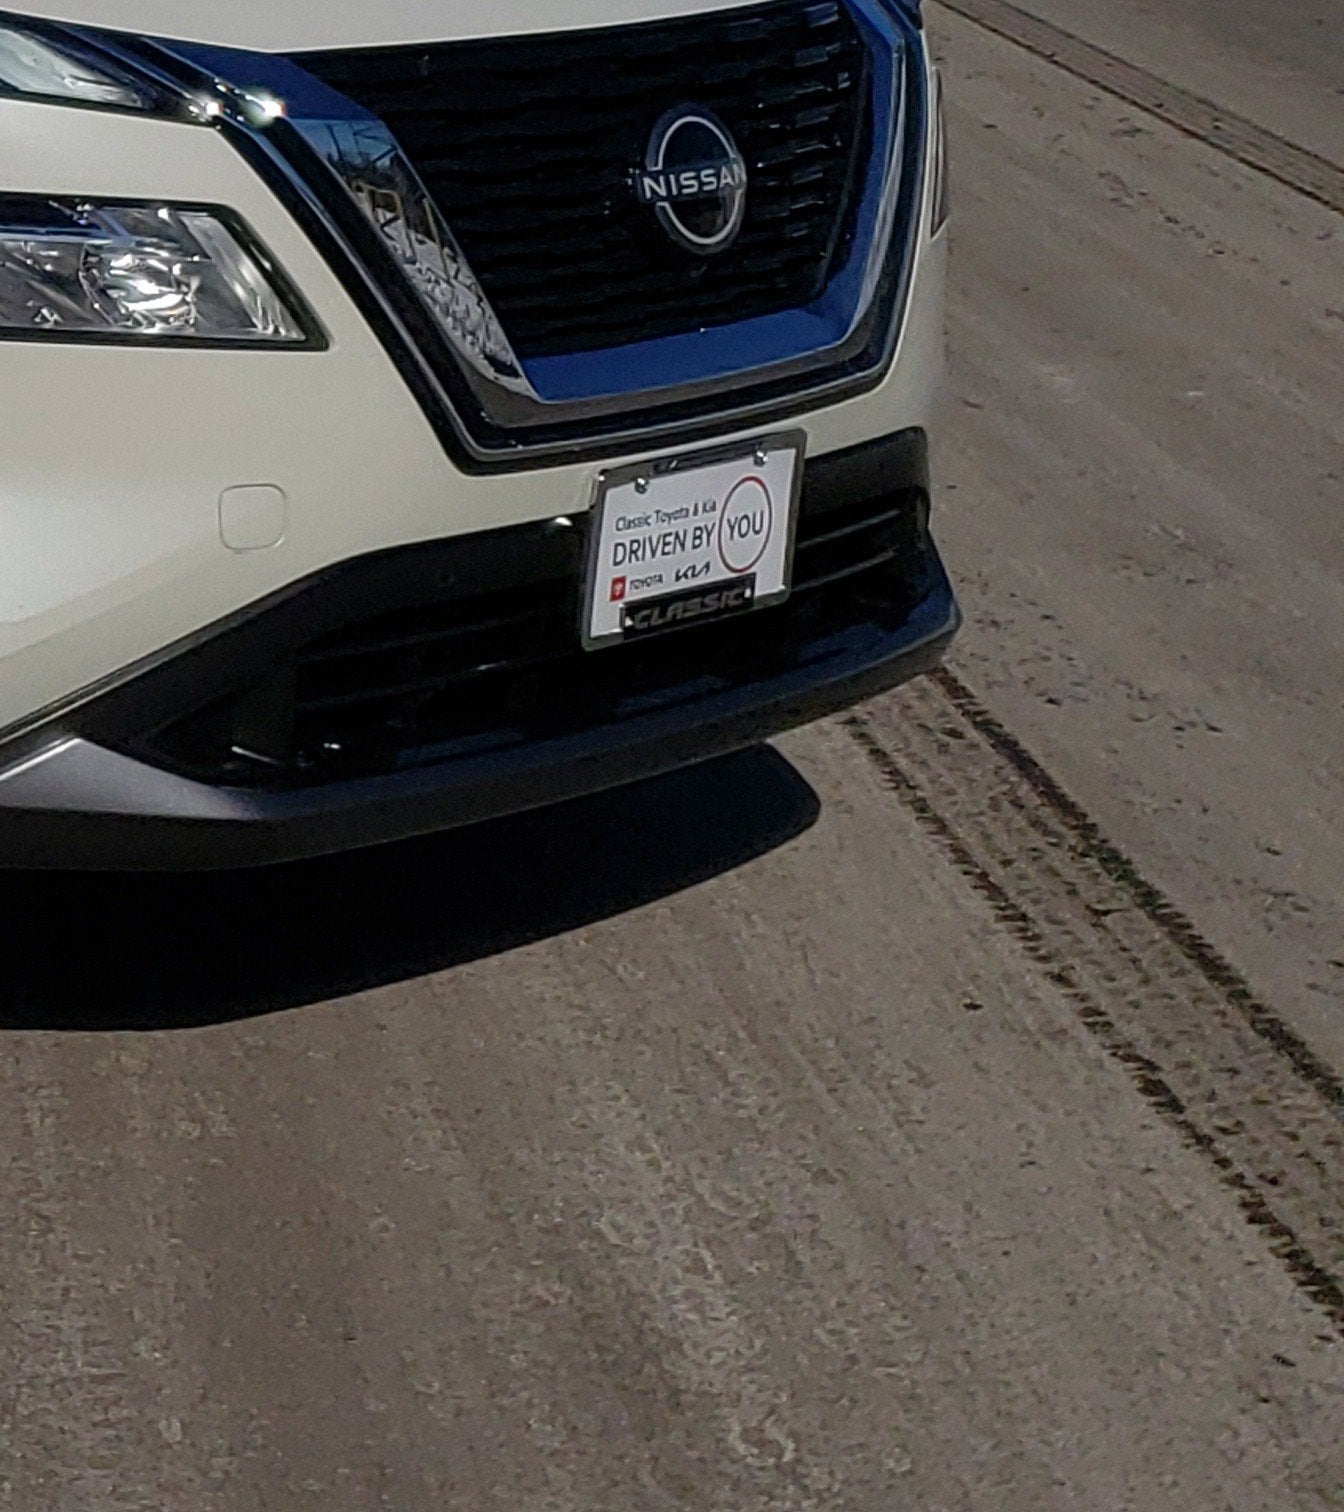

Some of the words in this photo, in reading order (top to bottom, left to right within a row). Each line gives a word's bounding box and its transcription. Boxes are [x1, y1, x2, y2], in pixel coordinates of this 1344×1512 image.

[642, 163, 742, 199] NISSAN
[613, 529, 687, 566] DRIVEN
[691, 521, 716, 550] BY
[727, 510, 764, 541] YOU
[615, 514, 652, 532] Classic
[632, 588, 746, 629] CLASSIC
